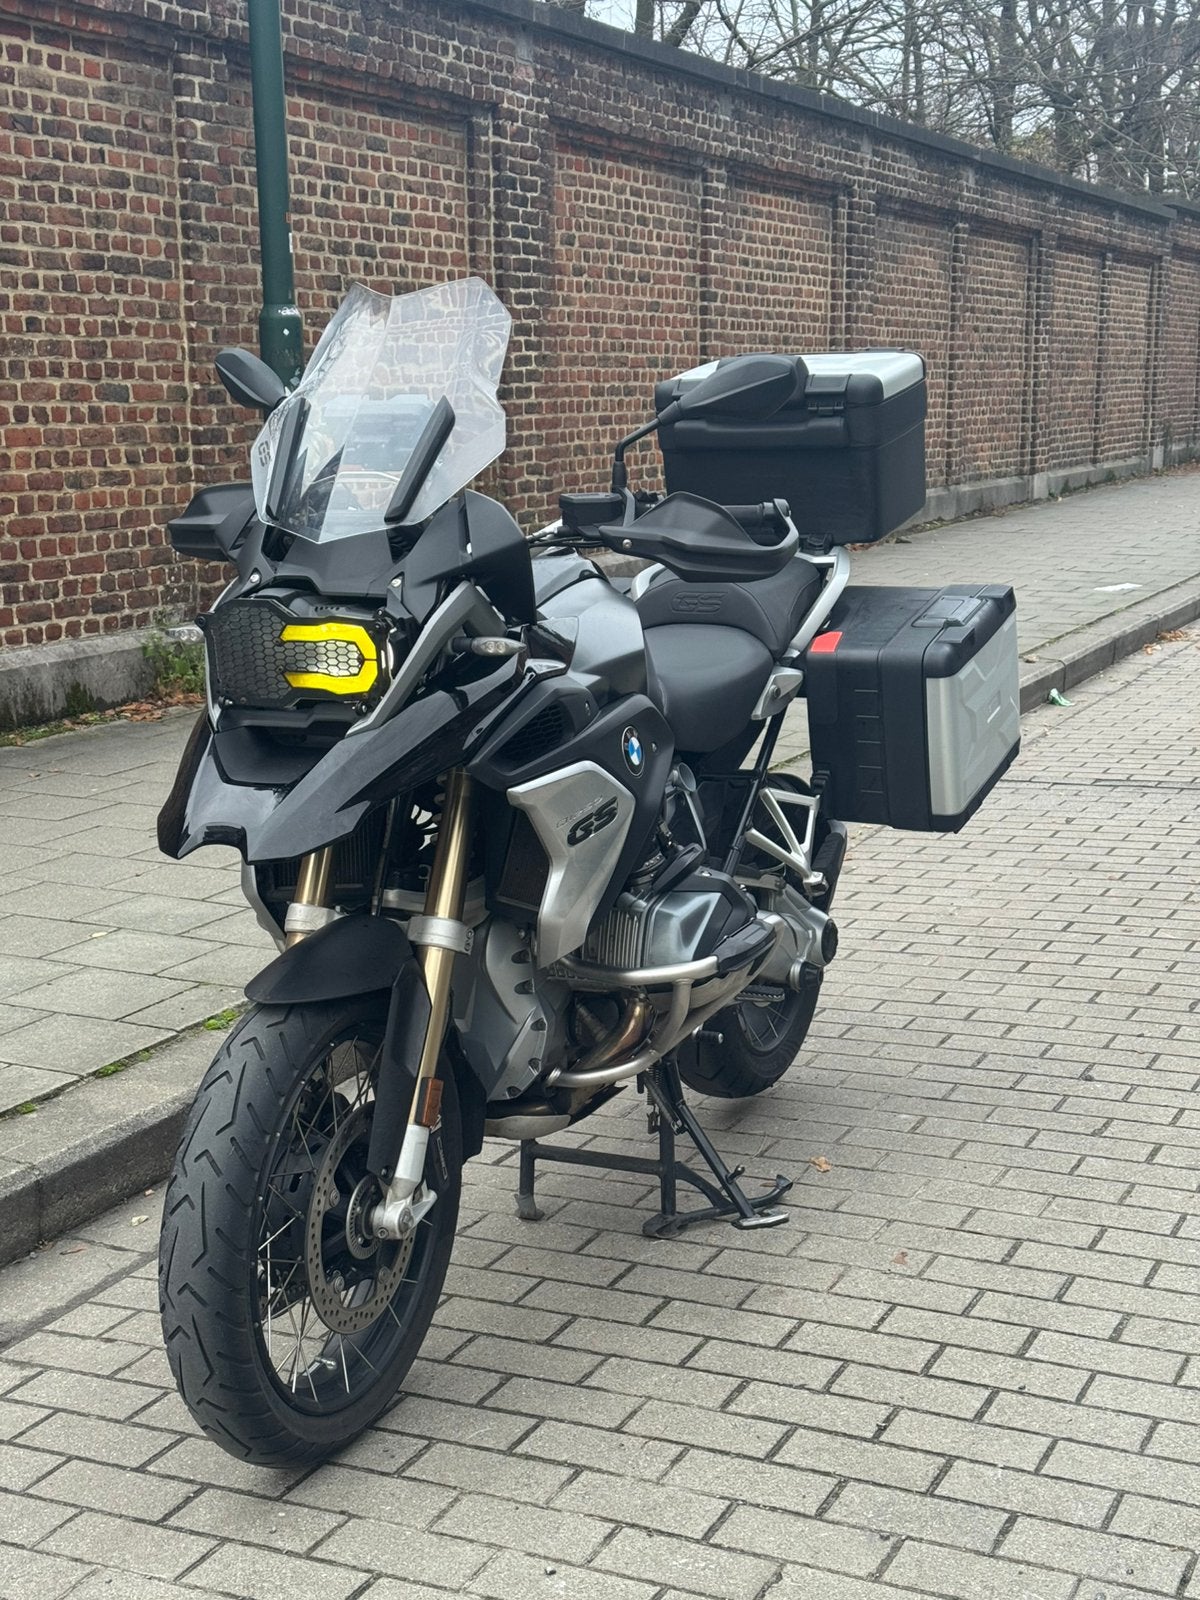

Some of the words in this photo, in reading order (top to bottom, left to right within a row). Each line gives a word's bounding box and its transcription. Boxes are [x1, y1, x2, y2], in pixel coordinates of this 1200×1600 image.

[258, 440, 272, 467] GS
[672, 591, 728, 614] GS
[567, 796, 618, 846] GS
